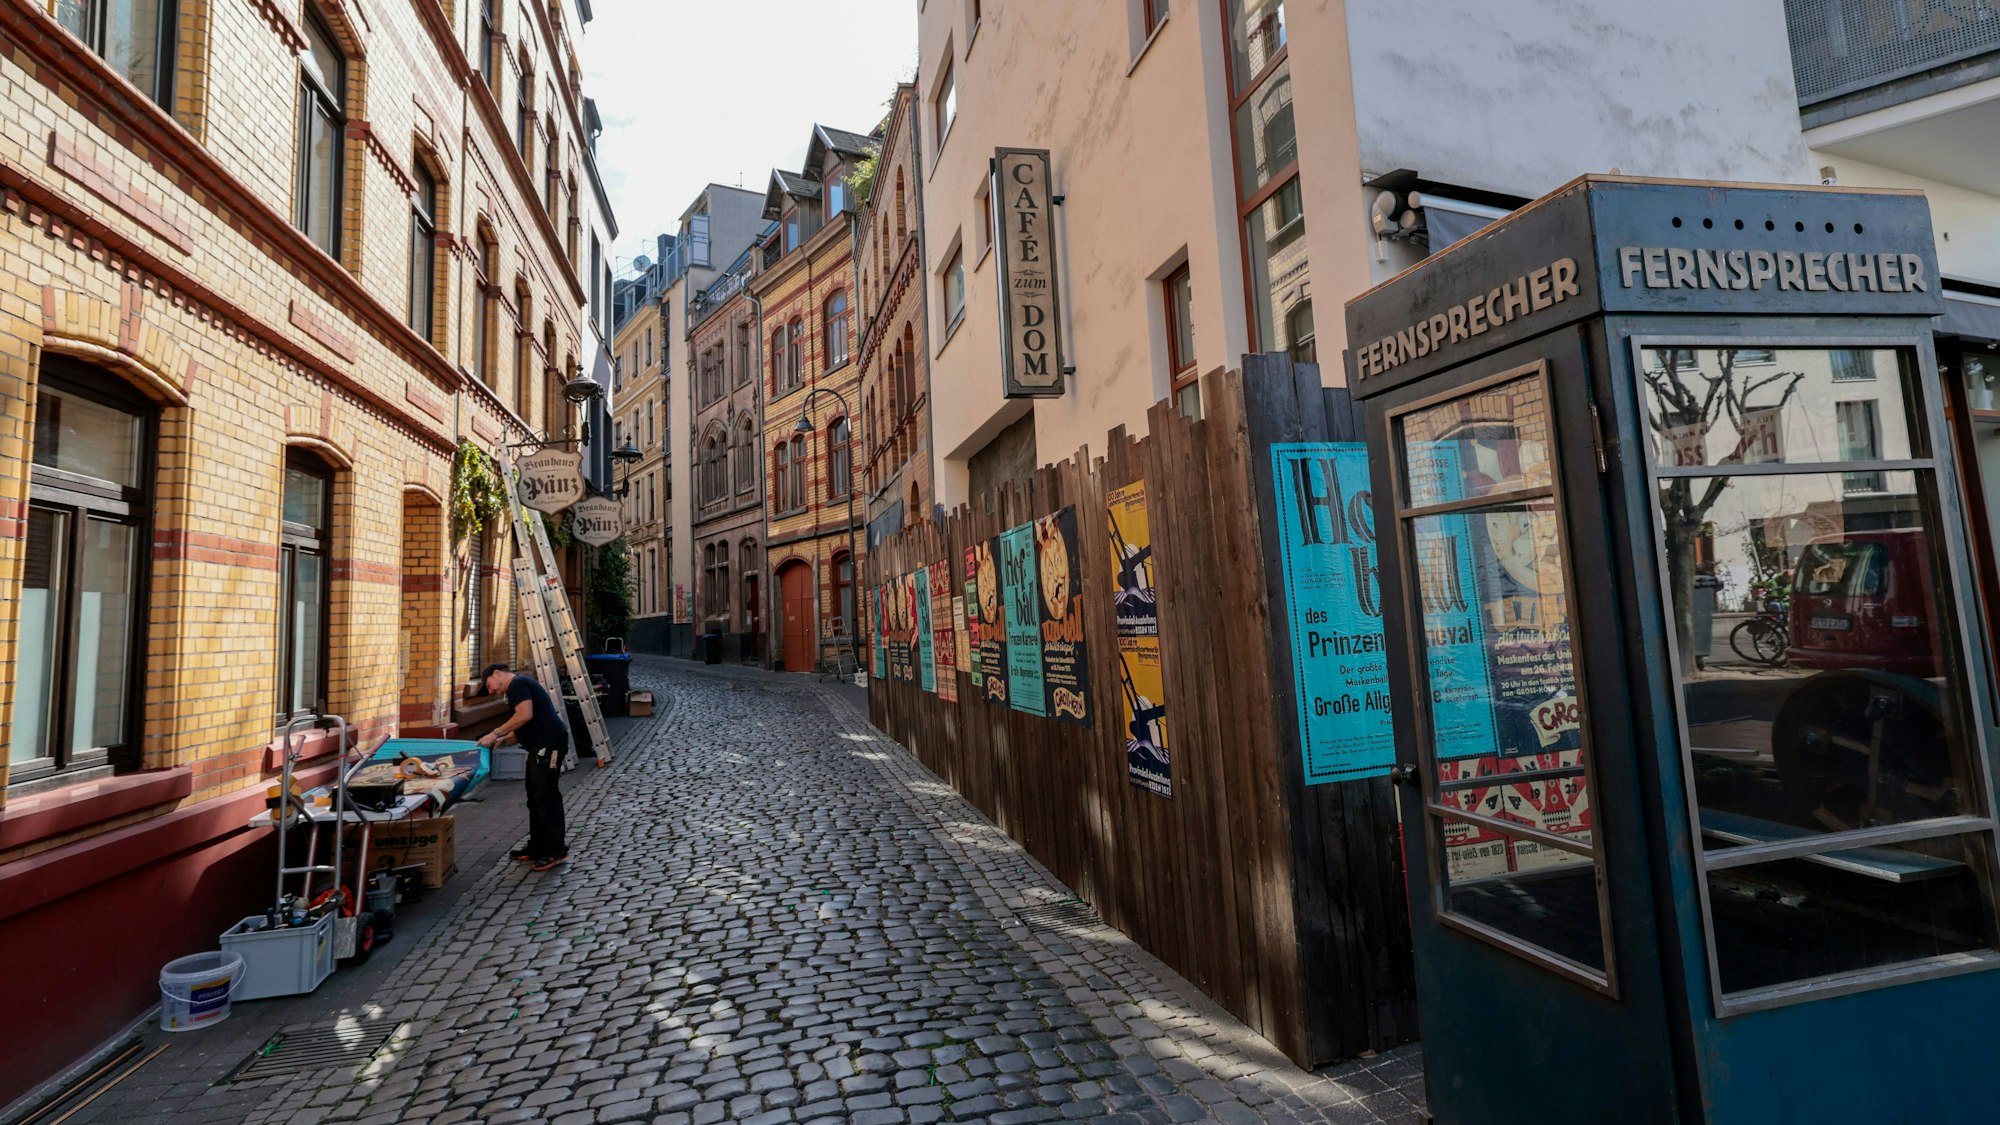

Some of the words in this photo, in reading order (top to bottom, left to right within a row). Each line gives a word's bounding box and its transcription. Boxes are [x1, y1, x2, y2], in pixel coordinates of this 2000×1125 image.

[1009, 164, 1039, 262] CAFÉ
[1618, 246, 1928, 292] FERNSPRECHER
[1014, 277, 1048, 289] zum
[1357, 257, 1581, 381] FERNSPRECHER
[1022, 305, 1049, 375] DOM
[522, 475, 580, 500] Pänz
[576, 517, 619, 535] Pänz
[1305, 607, 1328, 624] des
[1308, 631, 1385, 658] Prinzen
[1497, 655, 1541, 665] Maskenfest
[1542, 653, 1555, 661] der
[1340, 665, 1354, 675] Der
[1533, 663, 1547, 674] 26.
[1314, 694, 1360, 716] Große
[1464, 794, 1477, 805] 33
[1530, 788, 1541, 799] 19
[1565, 784, 1578, 795] 33
